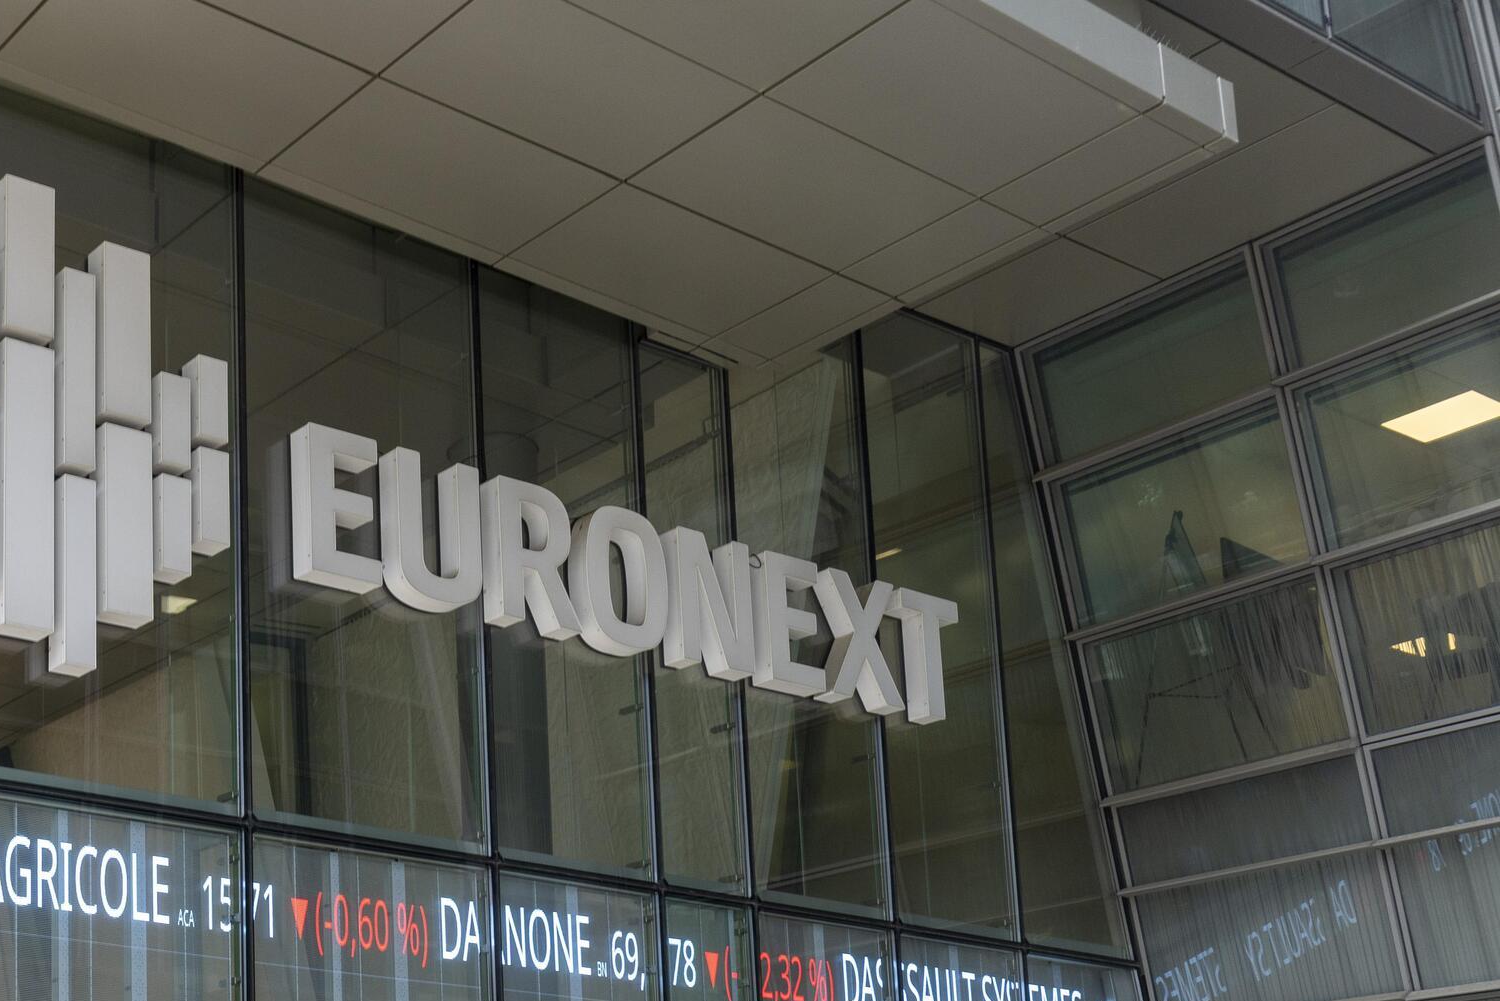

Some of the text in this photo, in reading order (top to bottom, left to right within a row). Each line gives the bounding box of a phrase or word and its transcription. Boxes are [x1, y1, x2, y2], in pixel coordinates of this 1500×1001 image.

[289, 421, 959, 725] EURONEXT
[177, 908, 196, 928] ACA
[202, 875, 274, 938] 1571
[315, 891, 390, 958] (-0,60
[597, 961, 608, 978] BN
